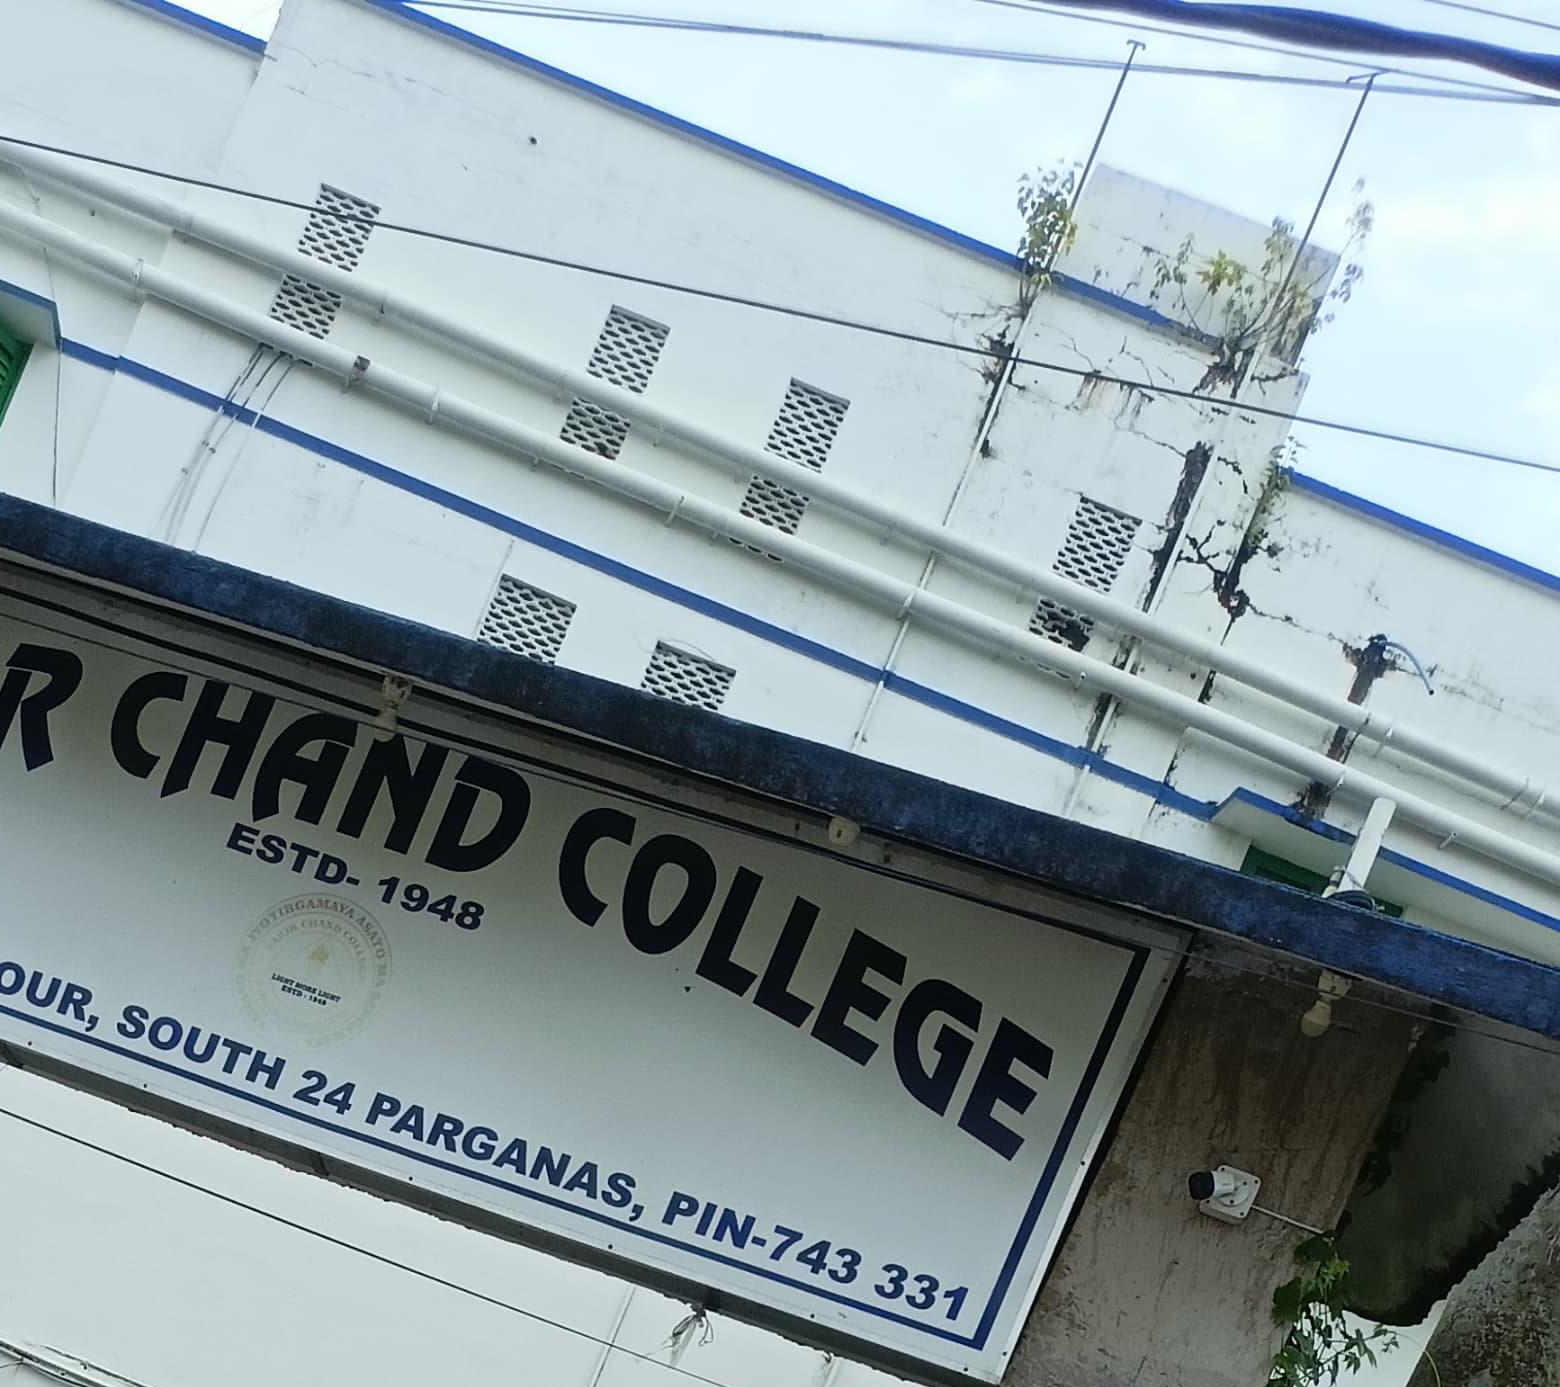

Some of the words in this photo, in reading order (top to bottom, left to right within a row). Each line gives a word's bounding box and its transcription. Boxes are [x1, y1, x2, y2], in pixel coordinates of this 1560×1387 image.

[111, 671, 532, 872] CHAND
[559, 808, 1054, 1161] COLLEGE
[227, 822, 359, 887] ESTD-
[378, 875, 485, 933] 1948
[116, 1005, 288, 1092] SOUTH
[293, 1070, 352, 1115] 24
[365, 1092, 644, 1222] PARGANAS,
[662, 1192, 863, 1284] PIN-743
[874, 1263, 968, 1322] 331
